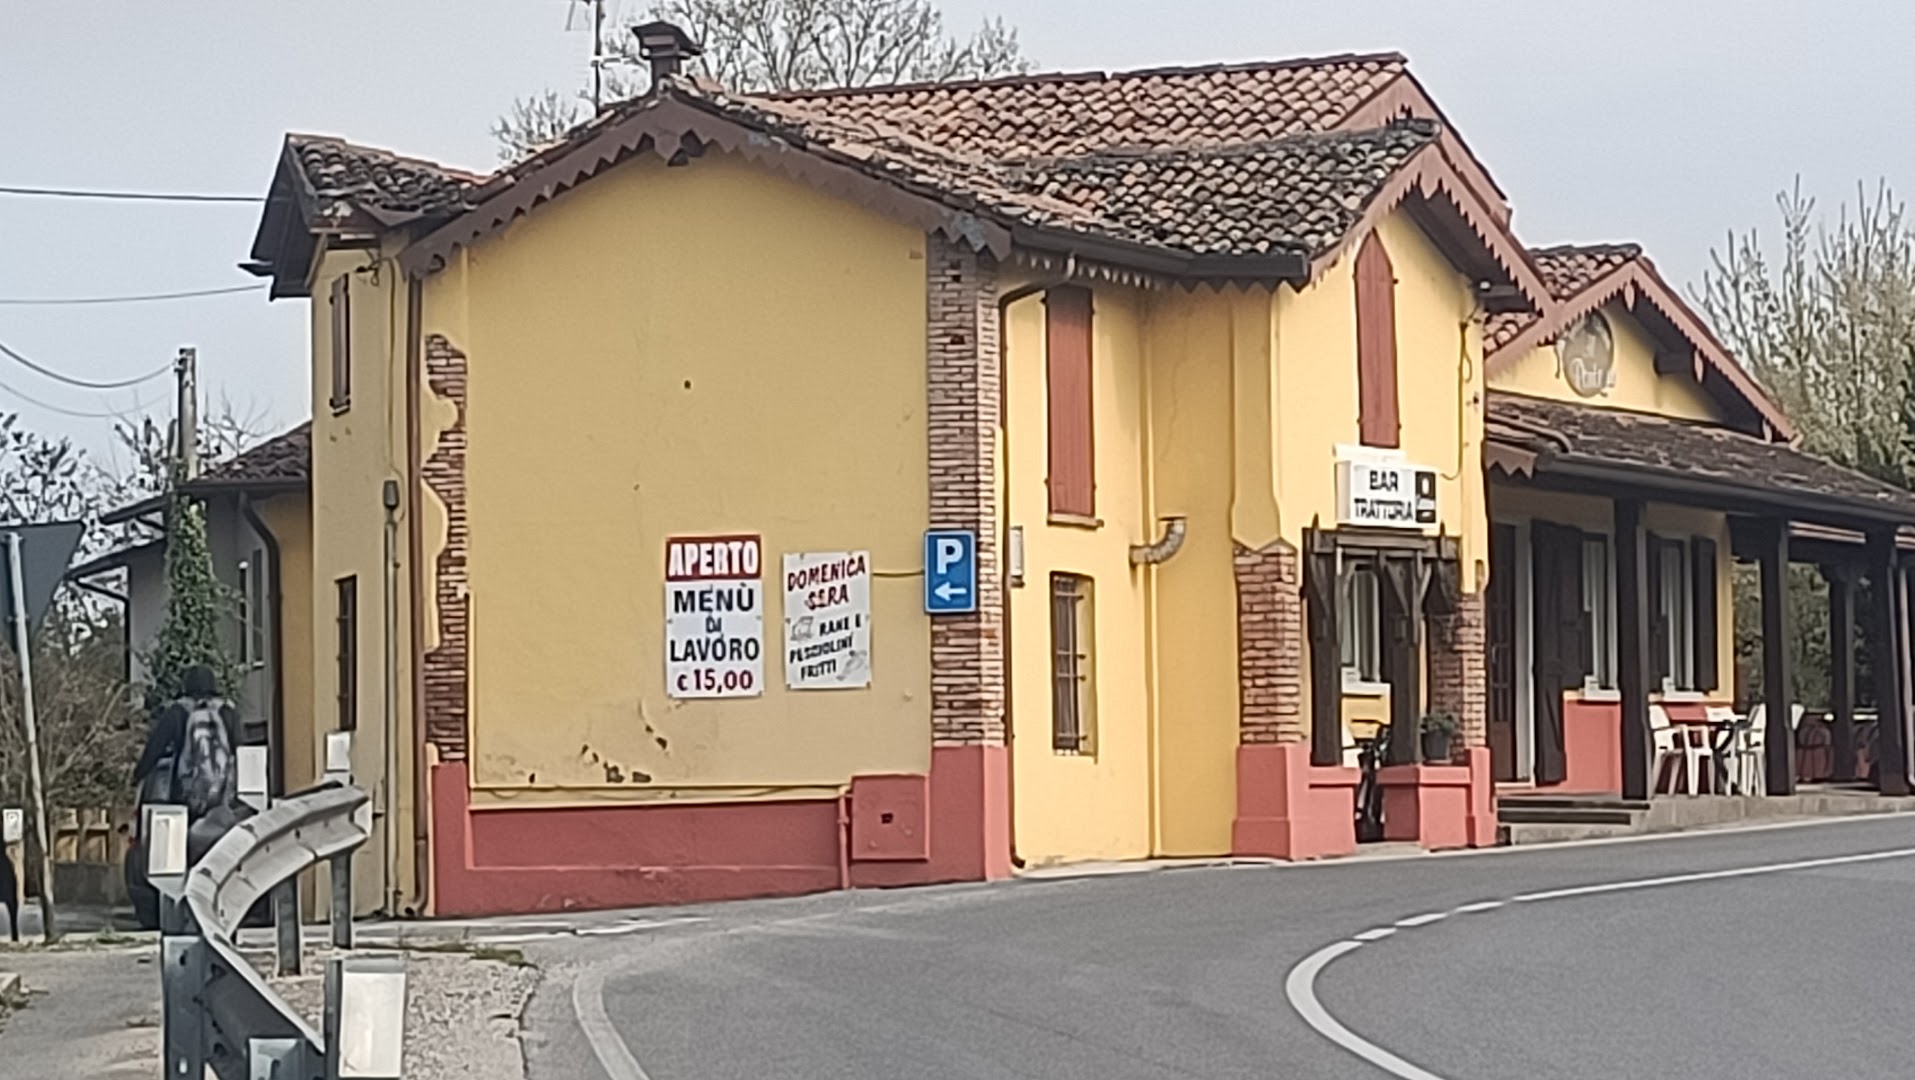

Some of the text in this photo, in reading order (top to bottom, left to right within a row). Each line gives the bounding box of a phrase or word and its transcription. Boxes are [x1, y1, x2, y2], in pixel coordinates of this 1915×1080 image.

[1369, 470, 1398, 492] BAR
[668, 540, 759, 577] APERTO
[936, 538, 964, 575] P
[787, 554, 866, 592] DOMENICA
[673, 582, 754, 613] MENÙ
[806, 584, 849, 611] SERA
[819, 613, 862, 637] RANE E
[669, 636, 760, 662] LAVORO
[694, 667, 754, 694] 15,00
[800, 658, 837, 681] FRITTI
